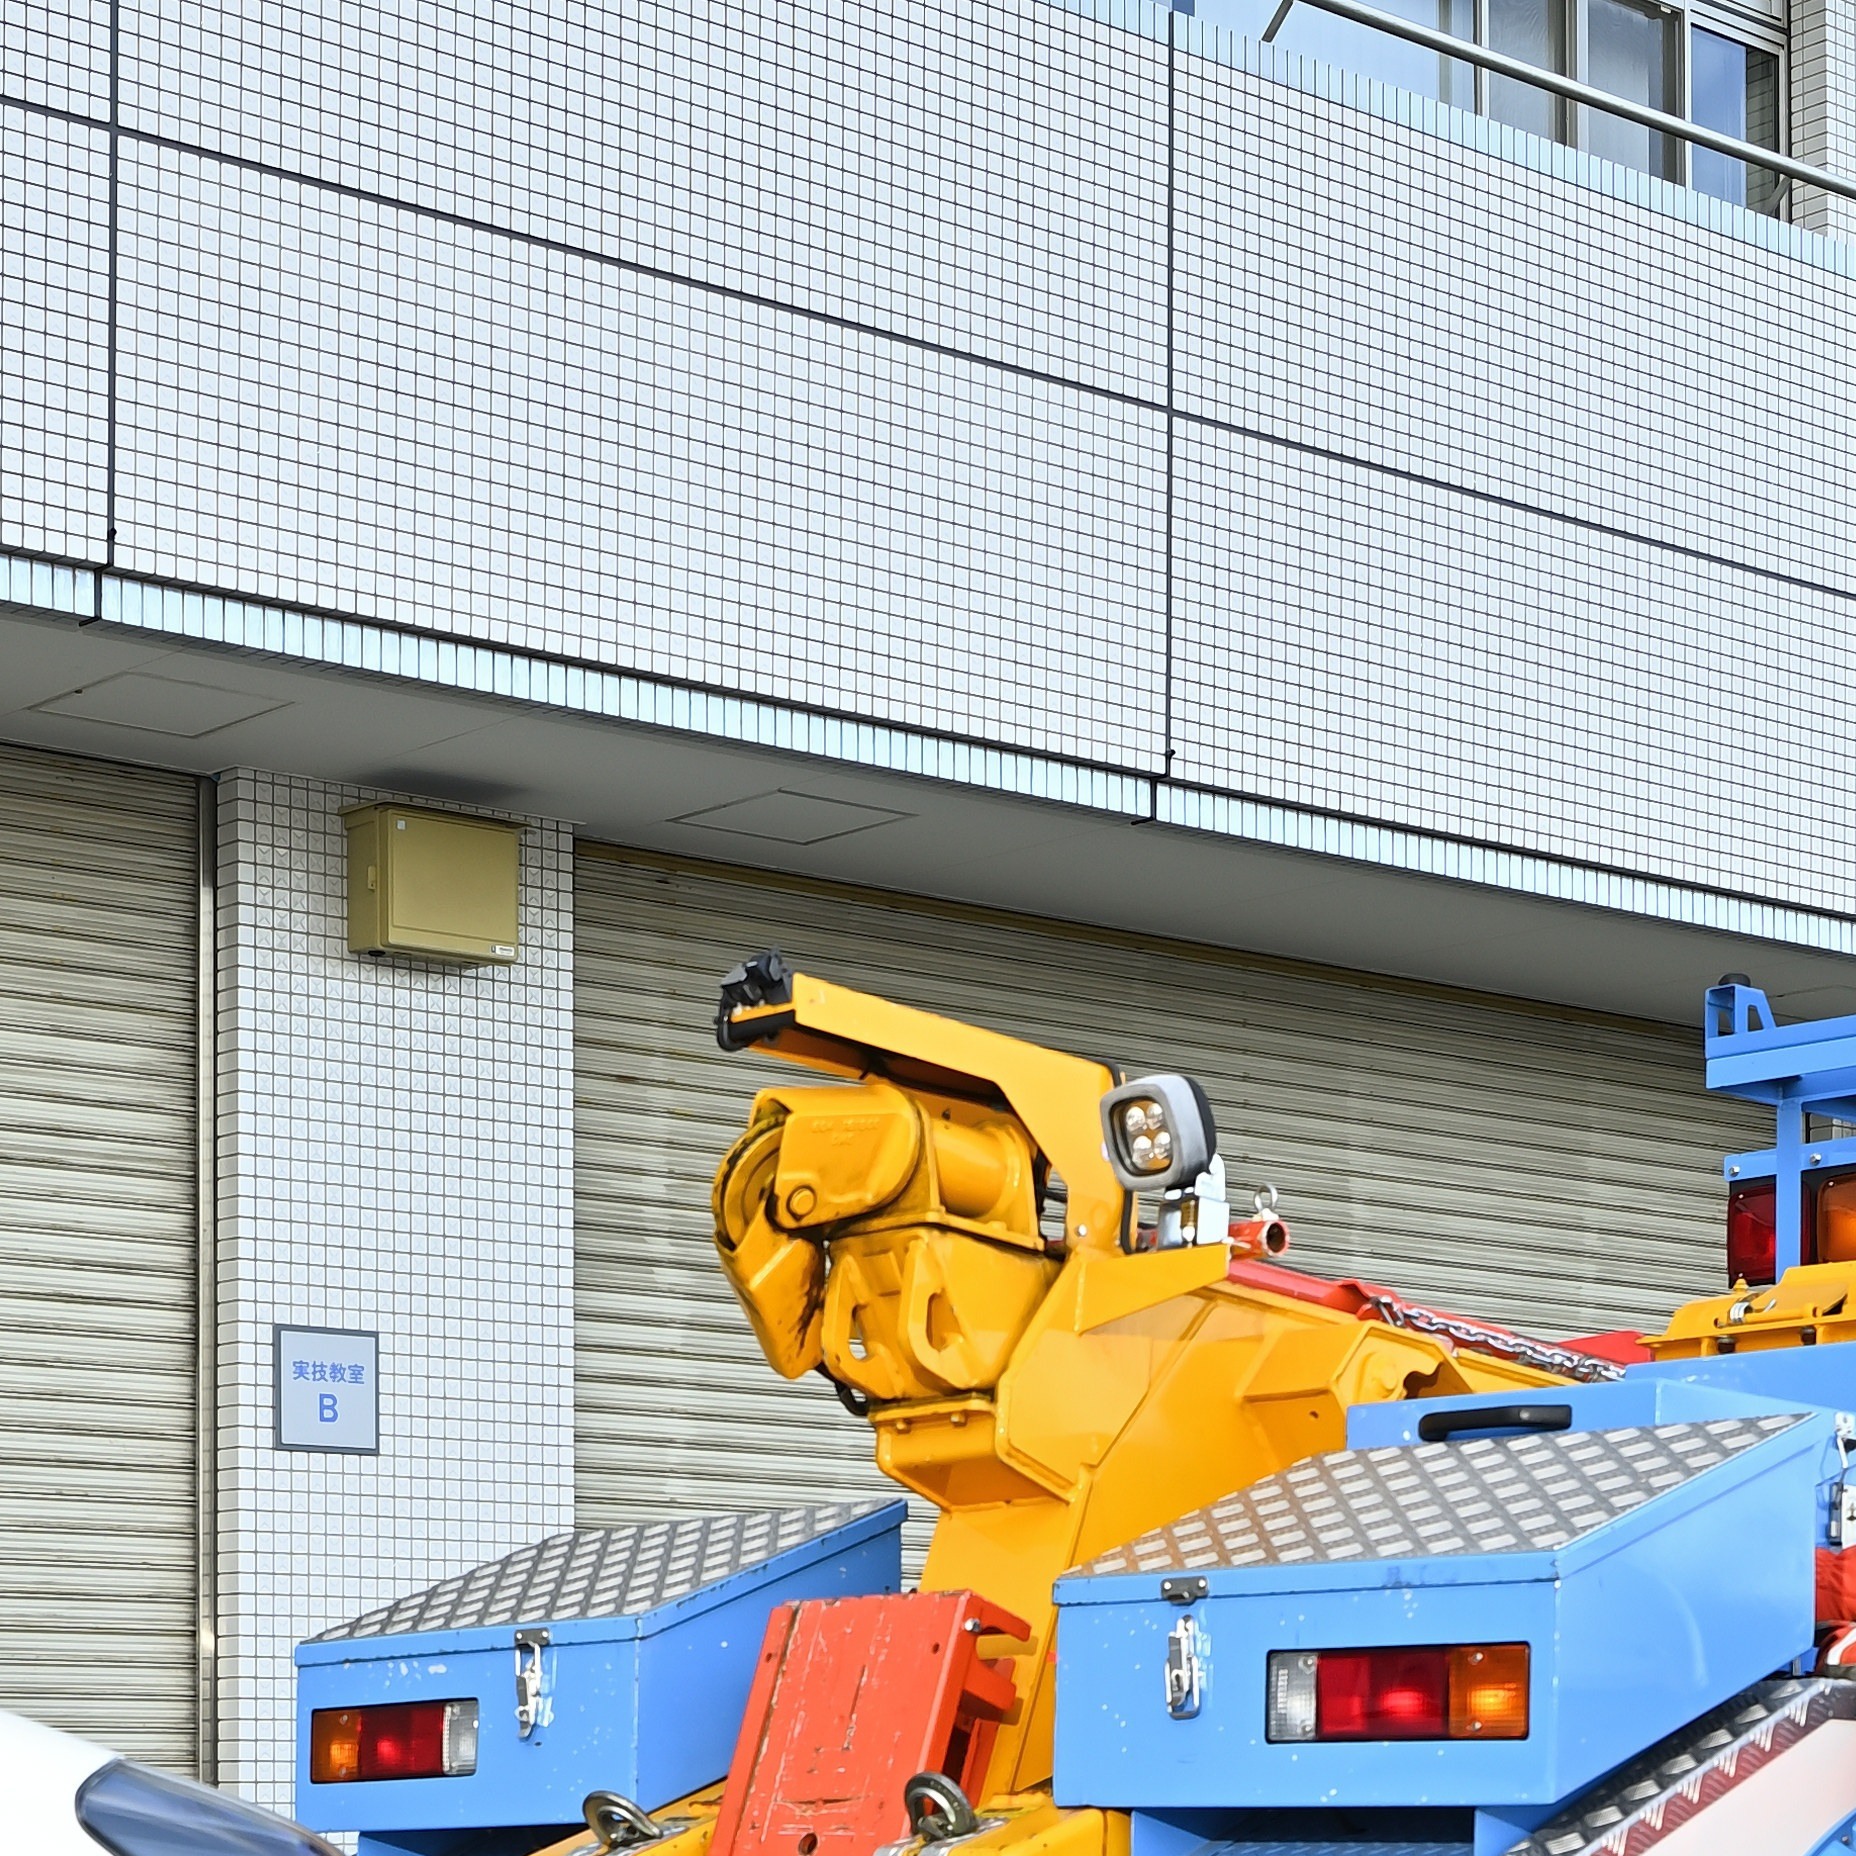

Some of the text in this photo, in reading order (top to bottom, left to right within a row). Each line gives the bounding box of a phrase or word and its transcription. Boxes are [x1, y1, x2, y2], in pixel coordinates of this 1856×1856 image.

[292, 1359, 365, 1385] 実技教室
[319, 1393, 338, 1423] B
